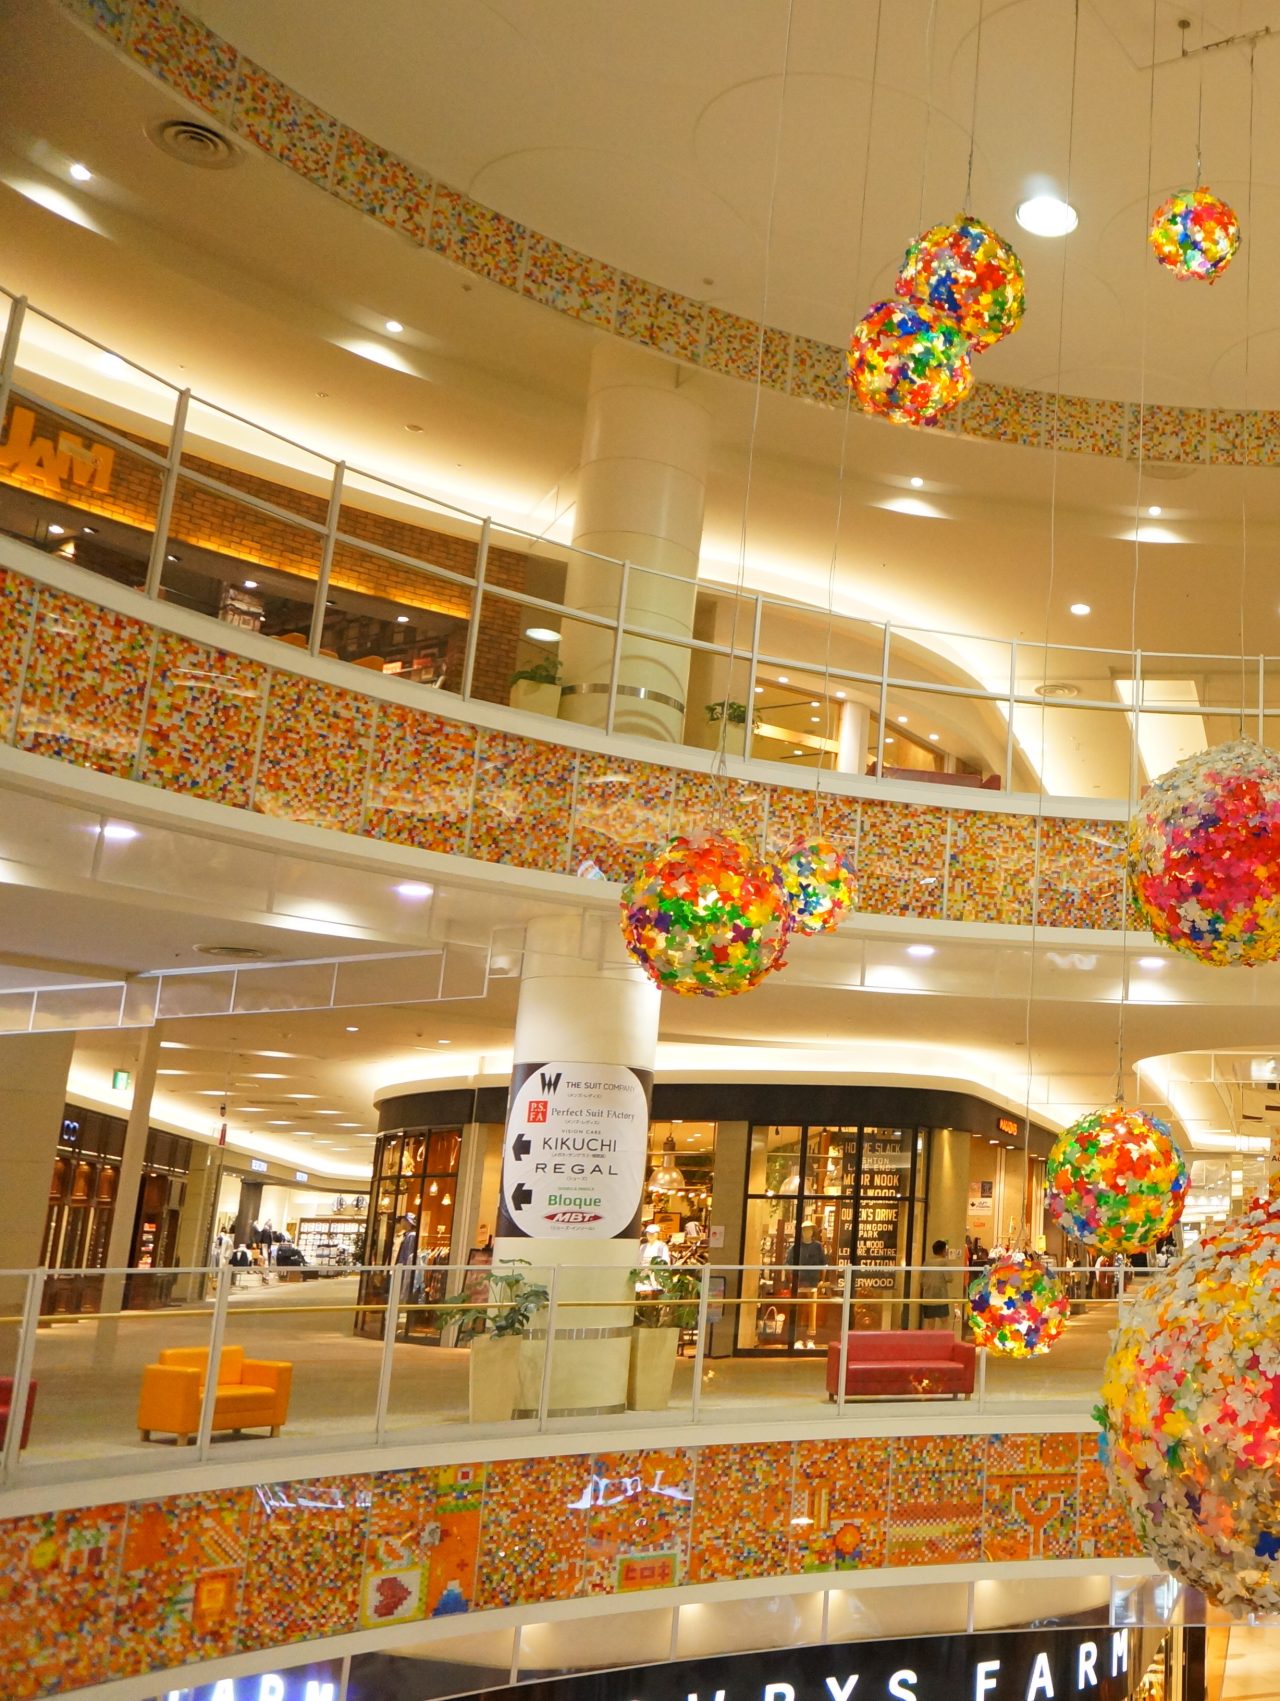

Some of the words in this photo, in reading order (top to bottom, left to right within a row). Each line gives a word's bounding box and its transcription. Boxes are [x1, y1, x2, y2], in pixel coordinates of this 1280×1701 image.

[566, 1081, 582, 1089] THE
[584, 1082, 602, 1090] SUIT
[603, 1084, 635, 1093] COMPANY
[551, 1108, 583, 1117] Perfect
[586, 1109, 604, 1118] Suit
[542, 1137, 617, 1152] KIKUCHI
[535, 1163, 618, 1176] REGAL
[874, 1175, 899, 1186] NOOK
[548, 1194, 602, 1209] Bloque
[875, 1209, 898, 1221] DRIVE
[870, 1248, 897, 1256] CENTRE
[974, 1628, 1129, 1701] FARM
